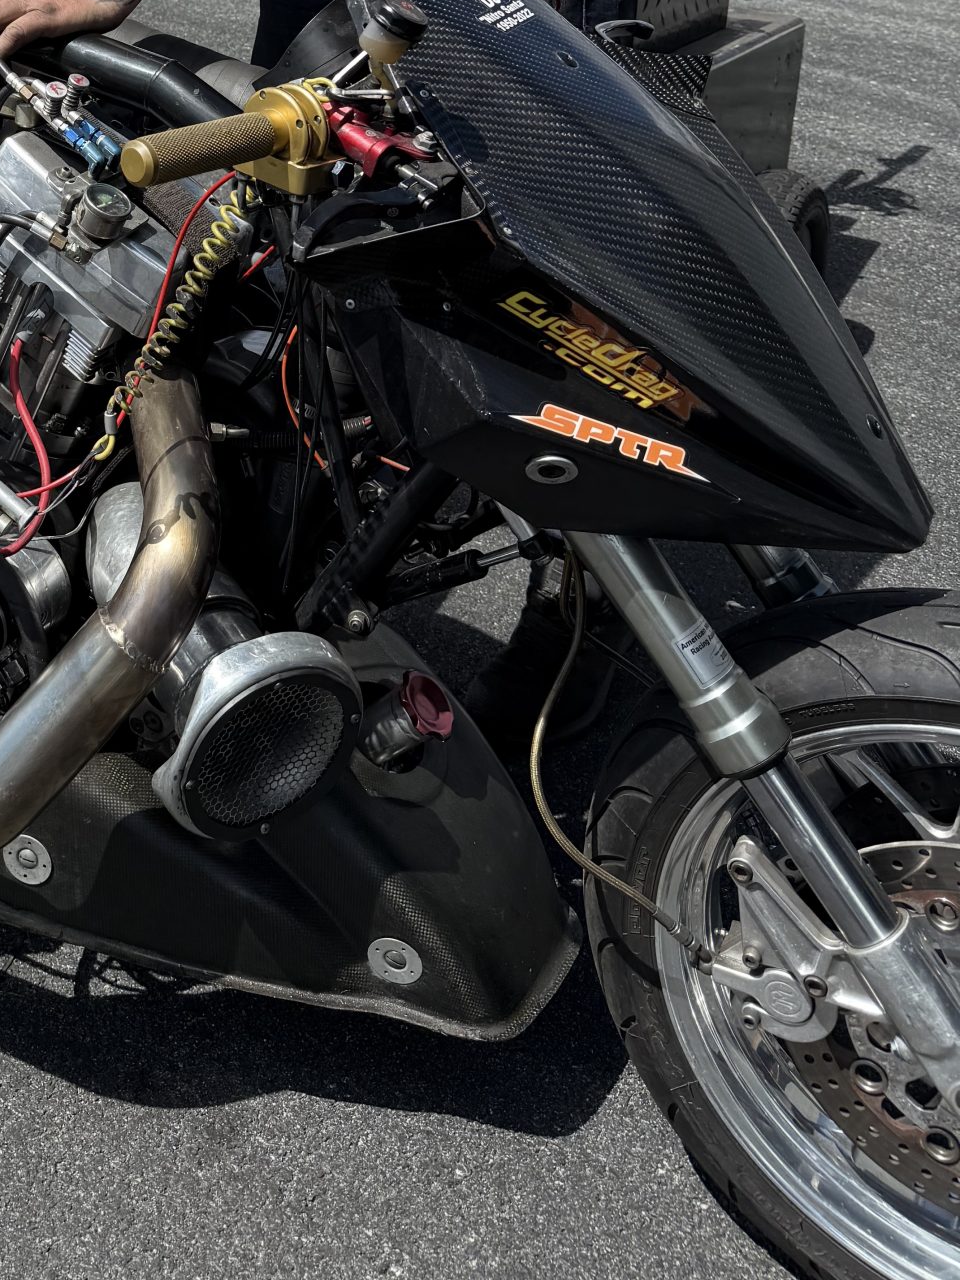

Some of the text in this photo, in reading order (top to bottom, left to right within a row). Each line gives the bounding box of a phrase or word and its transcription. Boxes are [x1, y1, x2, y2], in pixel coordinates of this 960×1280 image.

[496, 7, 535, 32] 1950-2022
[496, 291, 679, 402] CycleDrag
[543, 344, 655, 410] .com
[507, 403, 713, 483] SPTR
[690, 638, 710, 656] Racing
